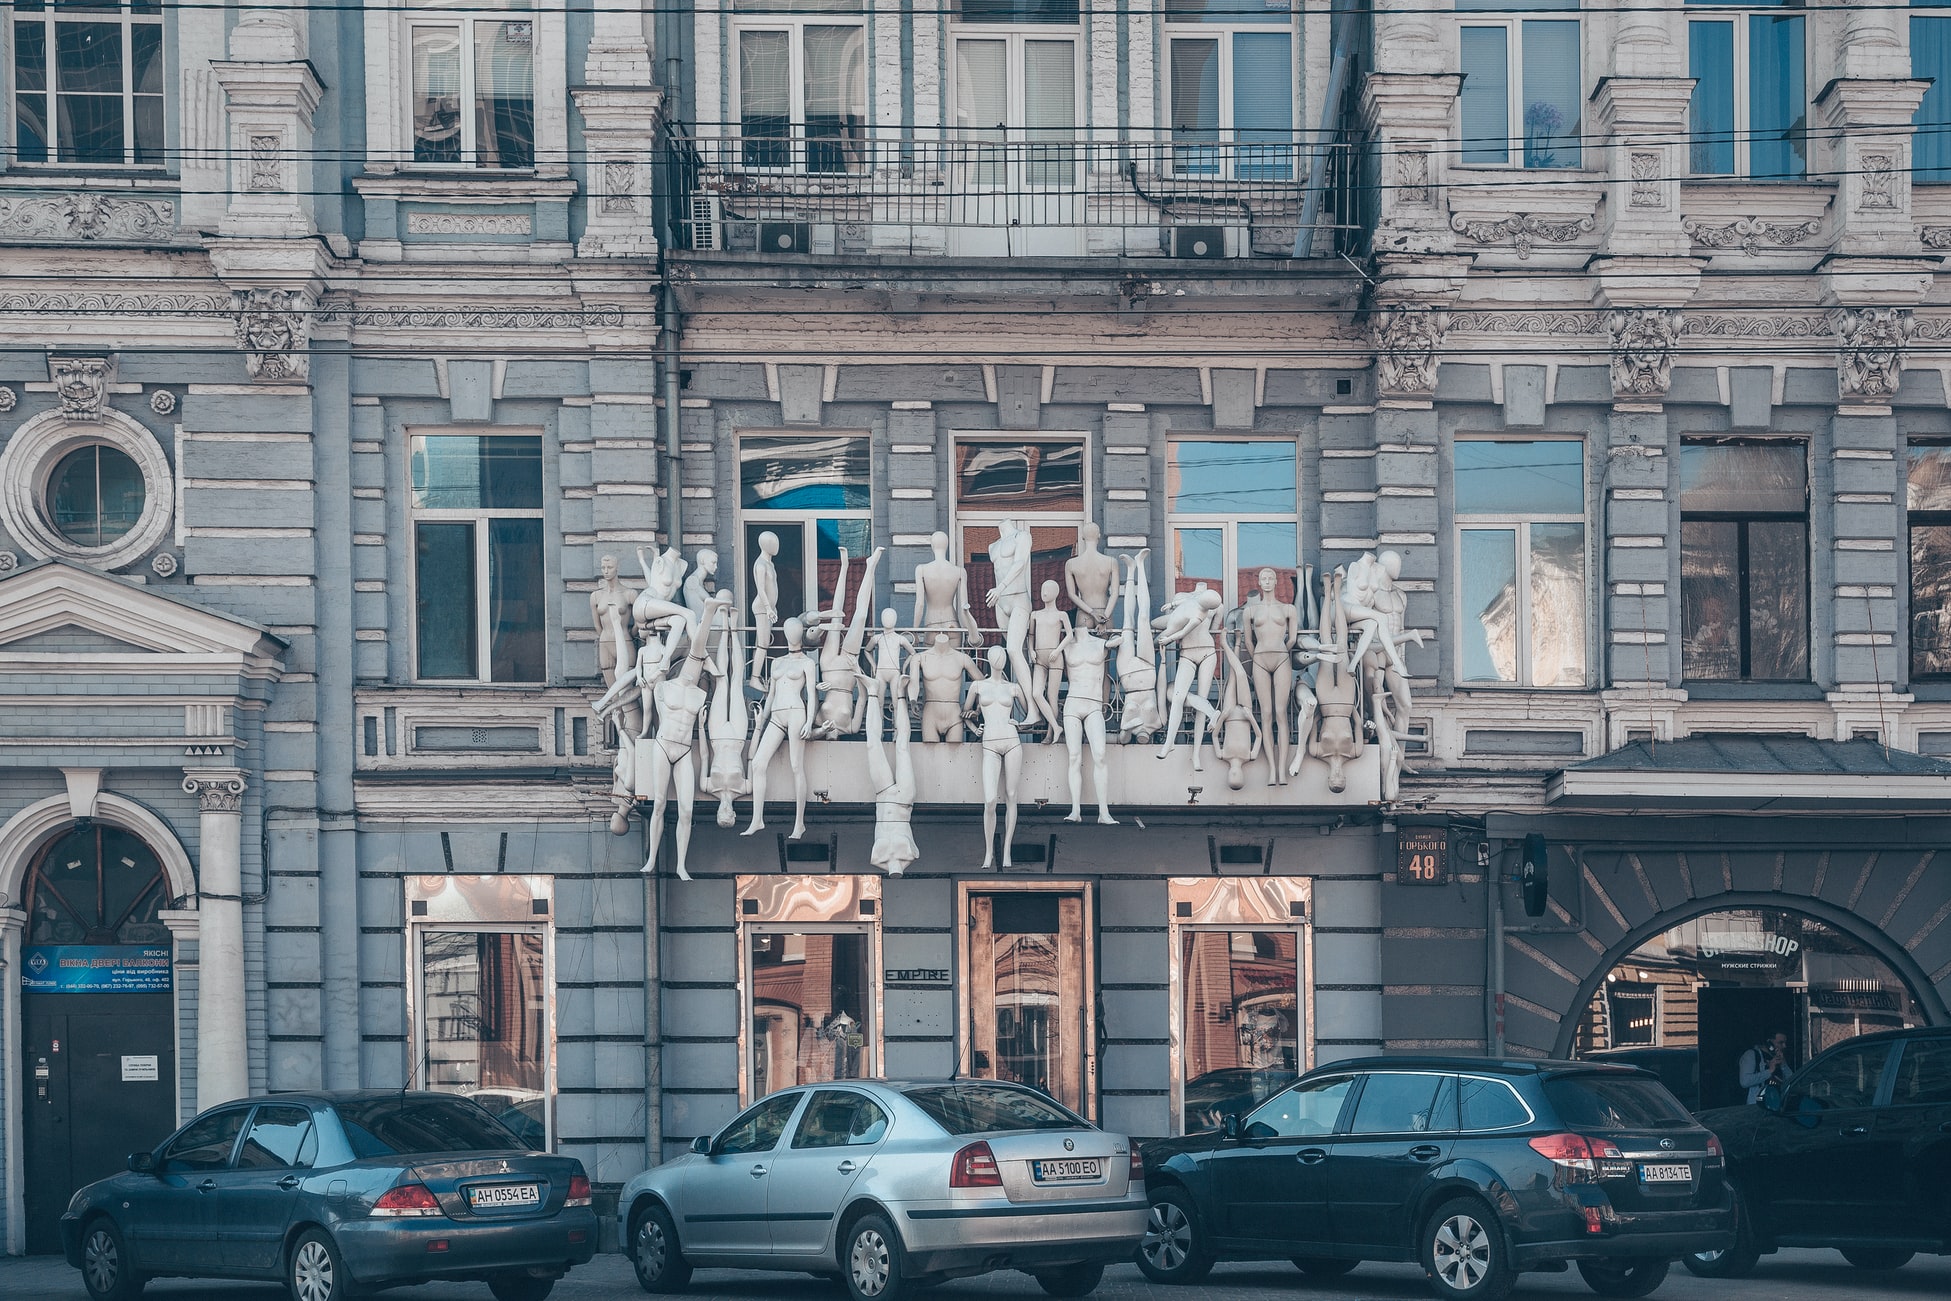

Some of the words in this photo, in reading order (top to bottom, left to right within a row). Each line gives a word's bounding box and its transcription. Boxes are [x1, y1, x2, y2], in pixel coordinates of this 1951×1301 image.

[1399, 841, 1446, 850] ГОРЬКОГО
[1409, 854, 1435, 880] 48
[59, 958, 89, 968] ВІКНА
[90, 958, 121, 968] ДВЕРІ
[122, 958, 169, 968] БАЛКОНИ
[885, 968, 949, 981] EMPIRE
[1042, 1163, 1057, 1176] AA
[1058, 1162, 1081, 1175] 5100
[1082, 1161, 1097, 1174] EO
[1645, 1167, 1659, 1180] AA
[1659, 1166, 1678, 1179] 8134
[1678, 1166, 1691, 1178] TE
[477, 1189, 493, 1203] AH
[494, 1188, 519, 1202] 0554
[520, 1187, 537, 1200] EA
